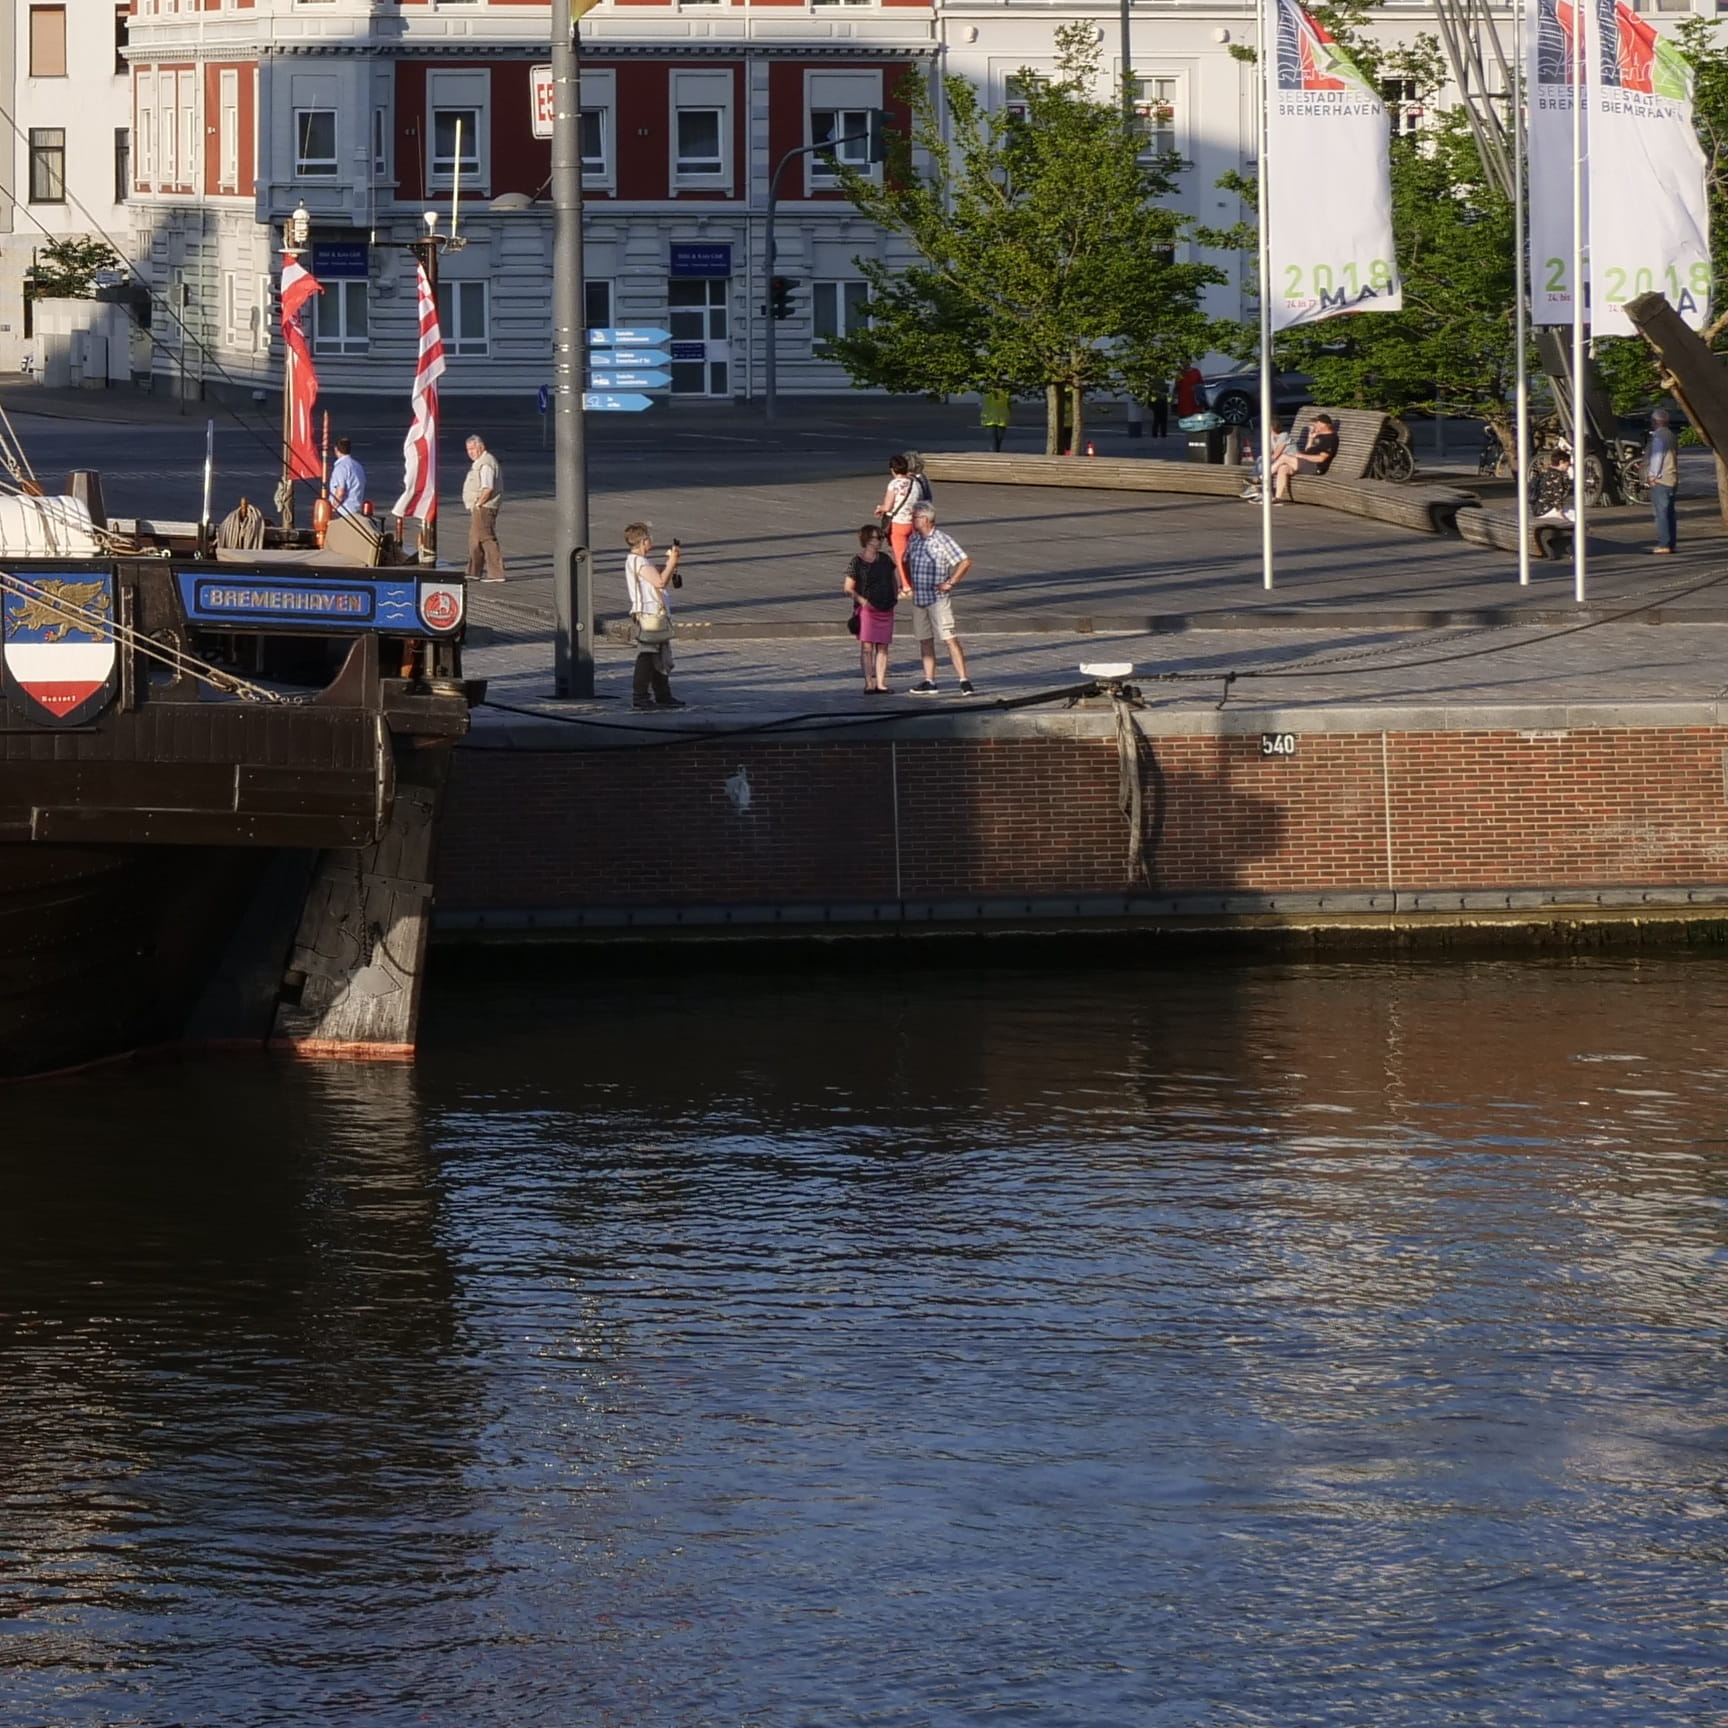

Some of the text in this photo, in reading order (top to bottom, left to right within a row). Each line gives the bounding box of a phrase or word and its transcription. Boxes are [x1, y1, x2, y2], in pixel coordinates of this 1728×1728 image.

[1279, 104, 1381, 116] BREMERHAVEN
[1284, 259, 1390, 299] 2018
[210, 589, 362, 612] BREMERHAVEN
[1263, 734, 1295, 754] 540
